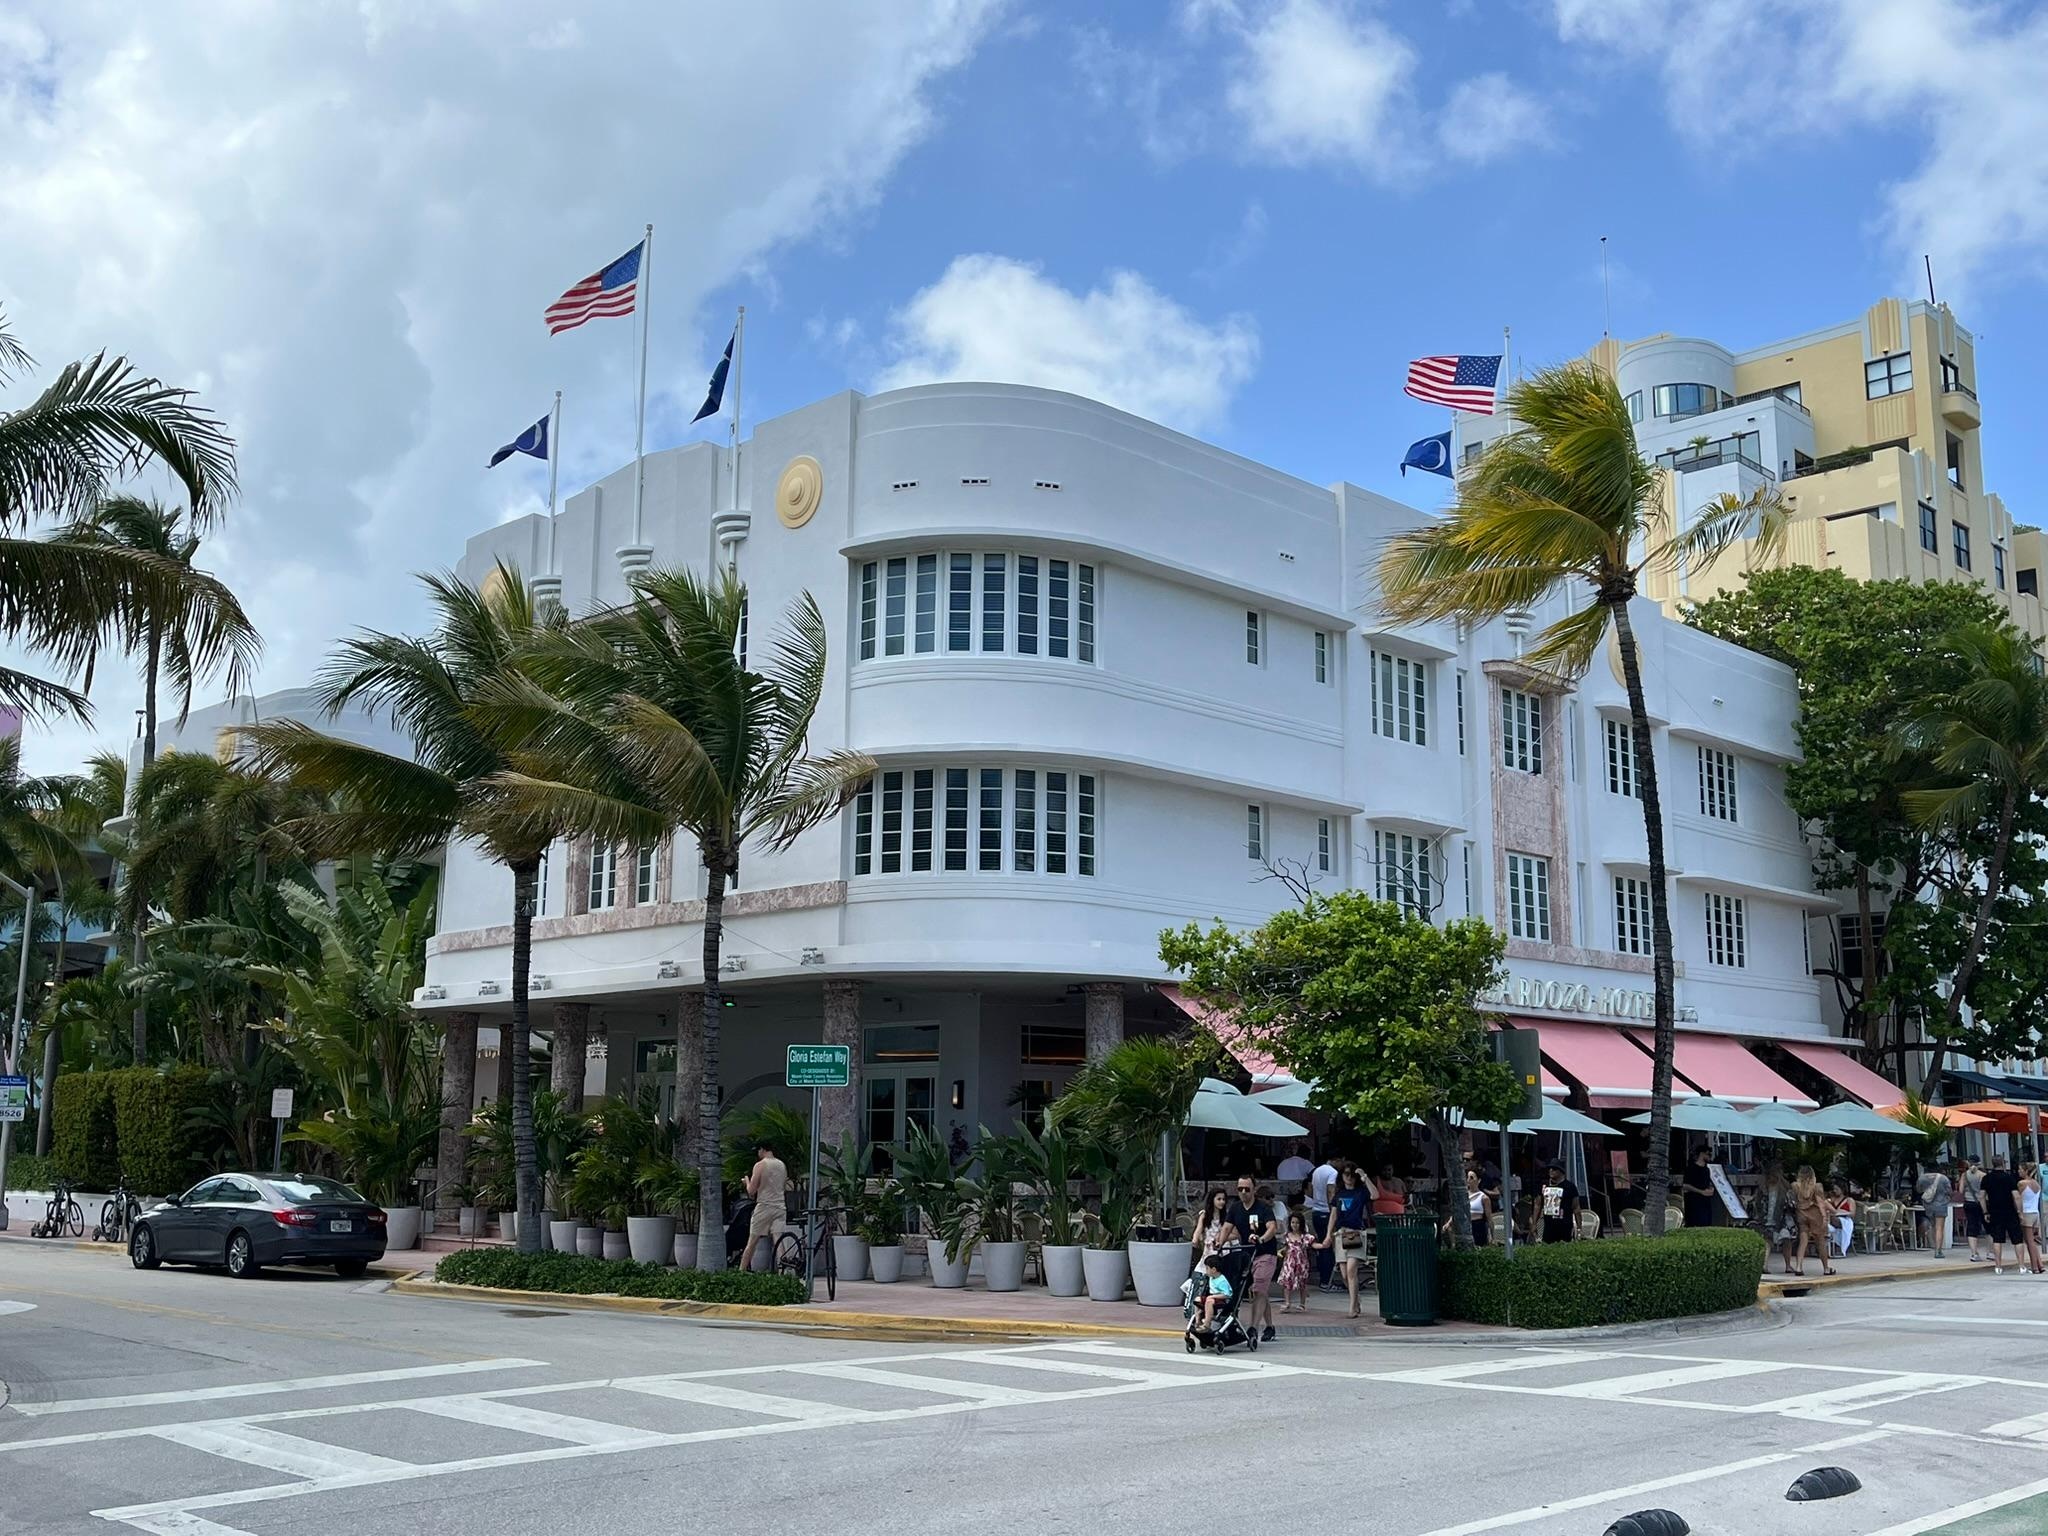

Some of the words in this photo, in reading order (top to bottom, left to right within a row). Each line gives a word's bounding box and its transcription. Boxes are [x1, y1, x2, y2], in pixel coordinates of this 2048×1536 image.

[1598, 986, 1656, 1018] HOTE
[789, 1049, 808, 1063] Gloria
[809, 1050, 833, 1063] Estefan
[834, 1050, 846, 1065] Way
